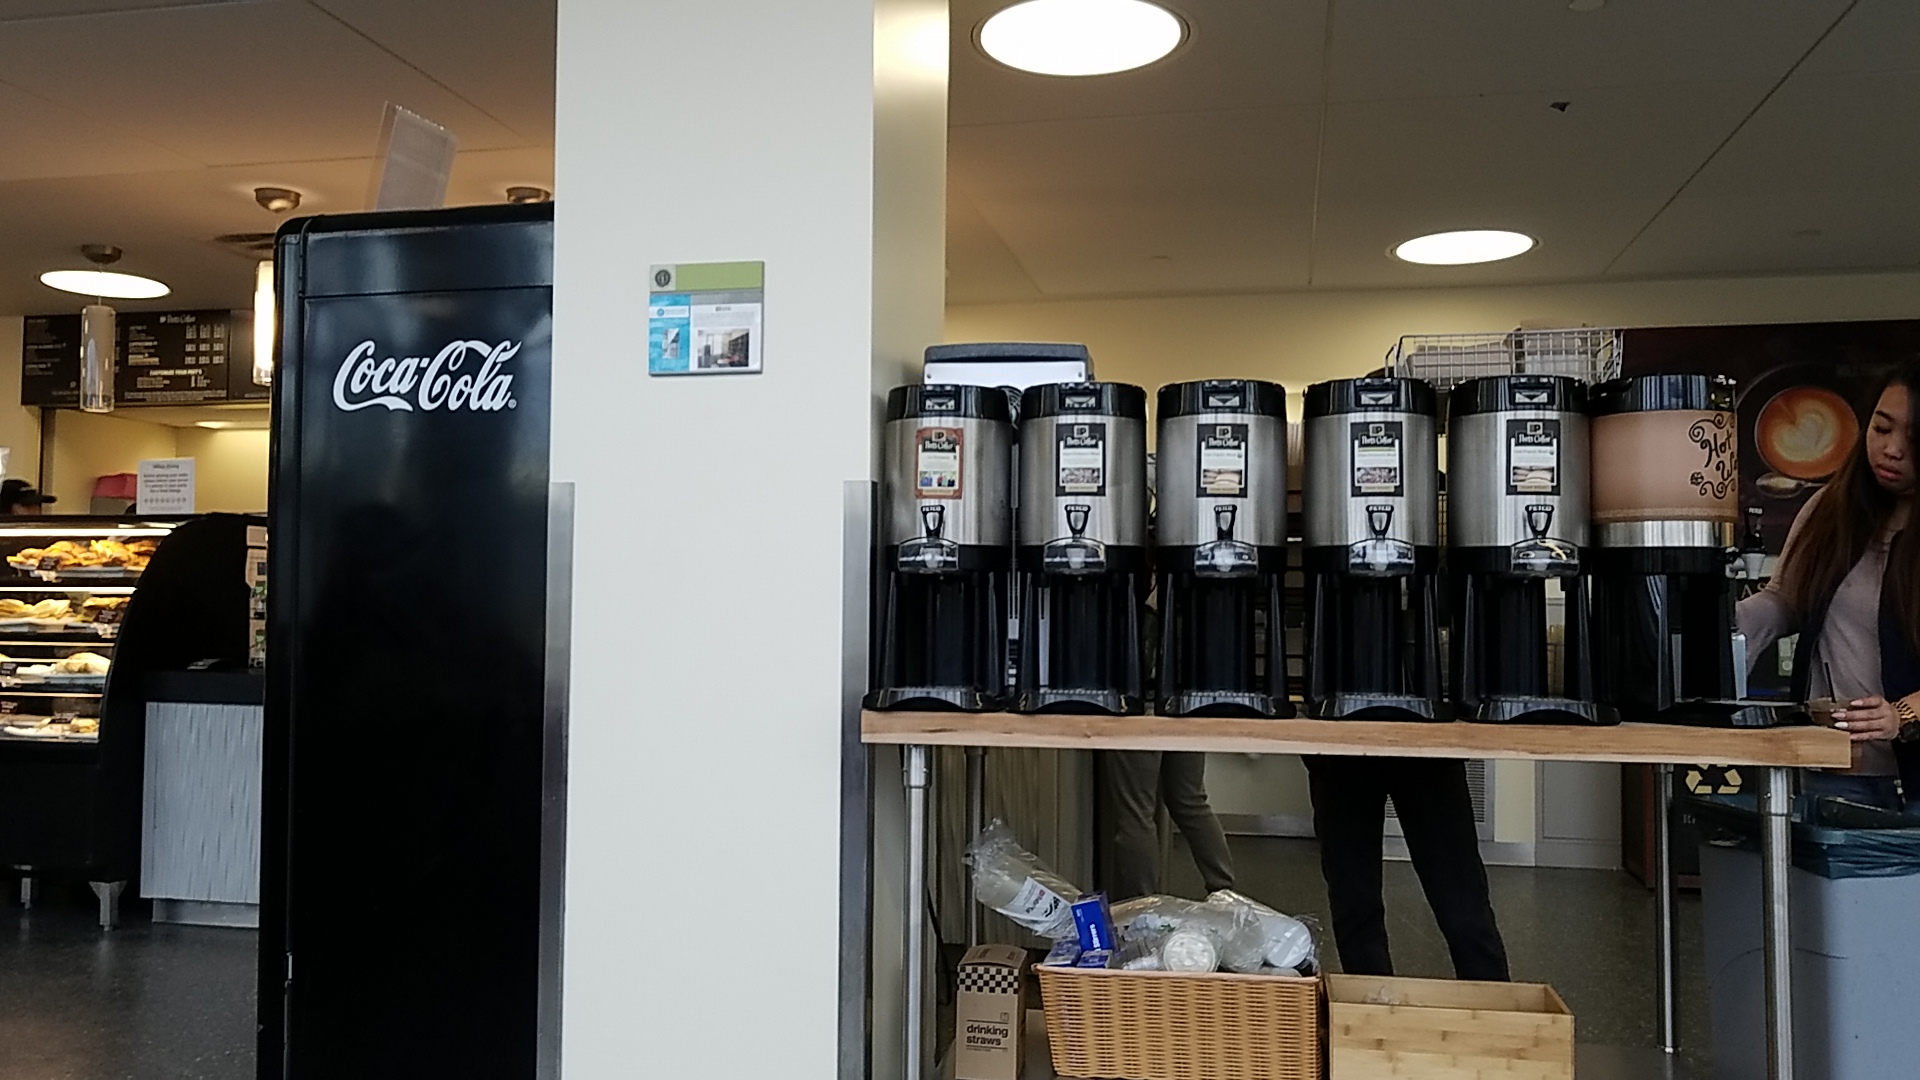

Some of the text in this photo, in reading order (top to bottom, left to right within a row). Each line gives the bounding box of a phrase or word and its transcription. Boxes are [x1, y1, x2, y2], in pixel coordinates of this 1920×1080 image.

[332, 339, 522, 412] Coca-Cola
[1700, 429, 1732, 468] Hot
[966, 1024, 1009, 1038] drinking
[966, 1034, 1002, 1046] straws
